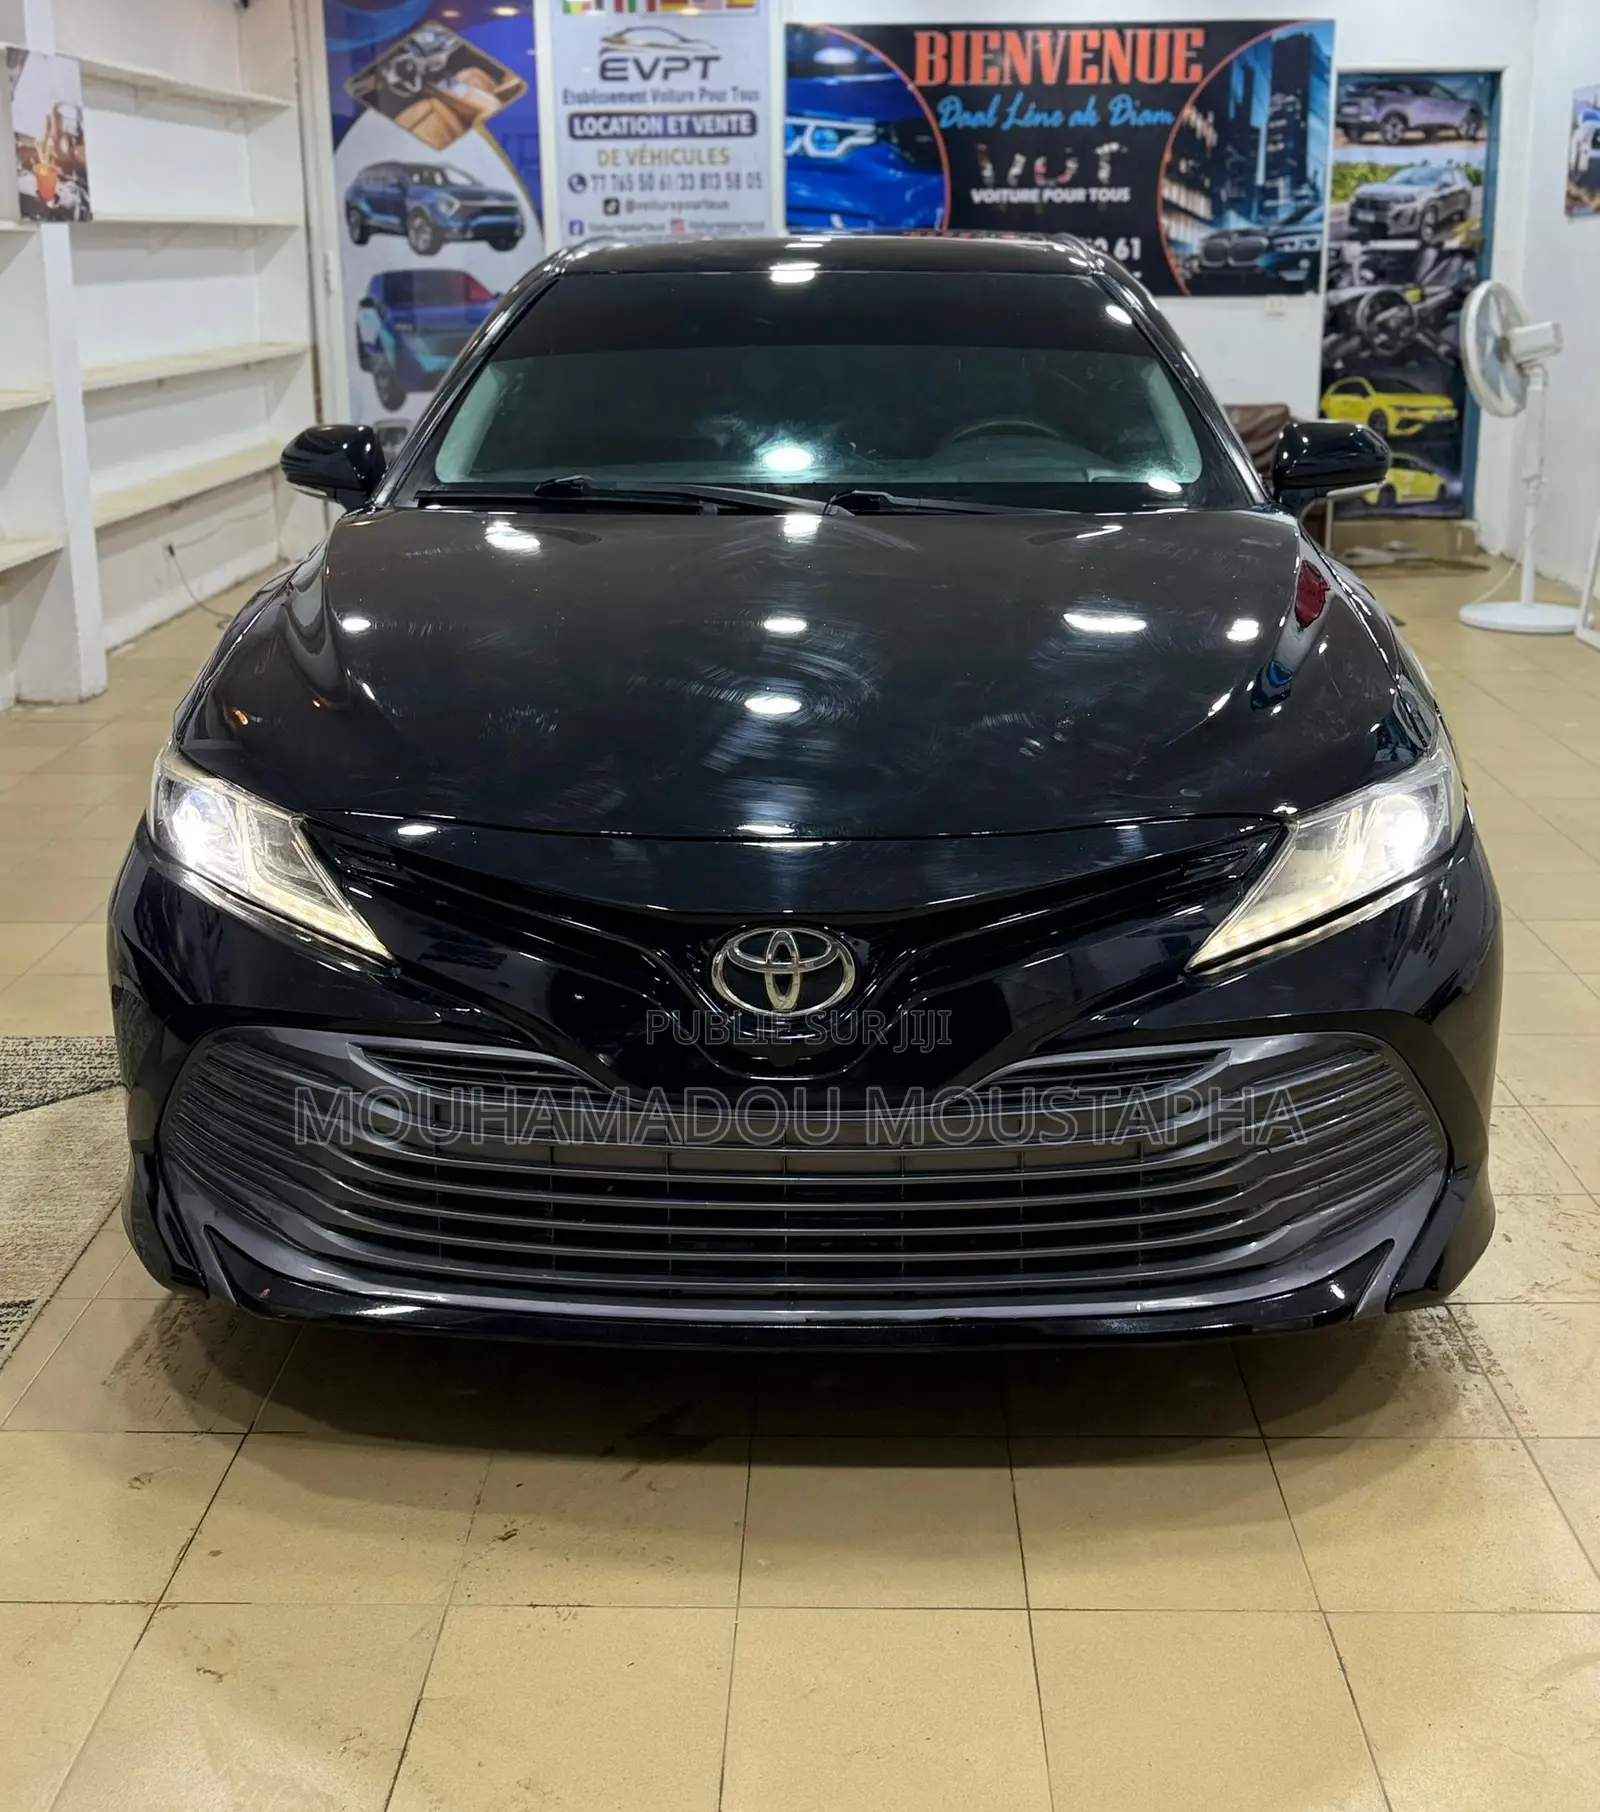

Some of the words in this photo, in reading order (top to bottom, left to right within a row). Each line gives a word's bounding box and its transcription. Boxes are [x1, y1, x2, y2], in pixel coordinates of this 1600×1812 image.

[600, 55, 721, 81] EVPT
[914, 28, 1205, 87] BIENVENUE
[698, 85, 728, 103] Pour
[731, 84, 761, 103] Tous
[573, 114, 664, 137] LOCATION
[667, 114, 689, 135] ET
[692, 113, 753, 135] VENTE
[597, 148, 622, 168] DE
[626, 144, 731, 167] VÉHICULES
[971, 188, 1040, 204] VOITURE
[1042, 187, 1087, 203] POUR
[1089, 186, 1132, 203] TOUS
[1113, 236, 1142, 261] 61
